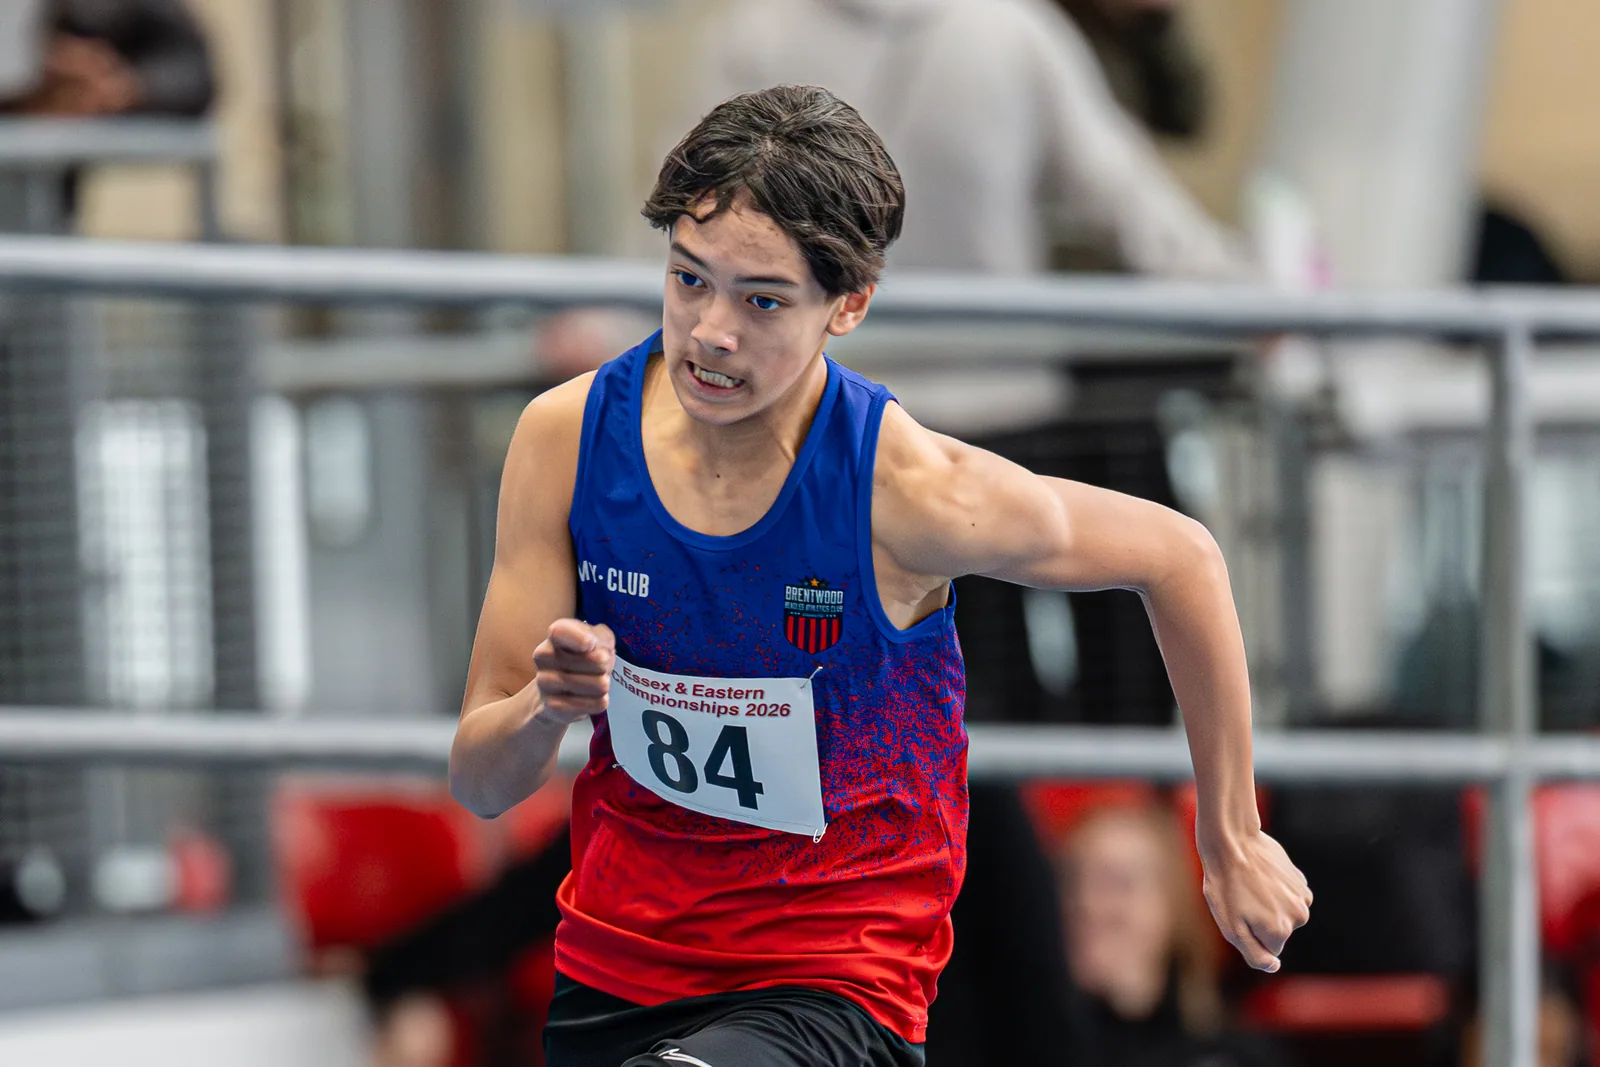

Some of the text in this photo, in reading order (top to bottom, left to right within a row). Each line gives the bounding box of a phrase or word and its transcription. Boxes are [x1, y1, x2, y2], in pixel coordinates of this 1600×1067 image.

[785, 586, 844, 604] BRENTWOOD
[612, 670, 791, 717] Championships 2026
[623, 666, 765, 700] Essex & Eastern
[641, 709, 765, 811] 84
